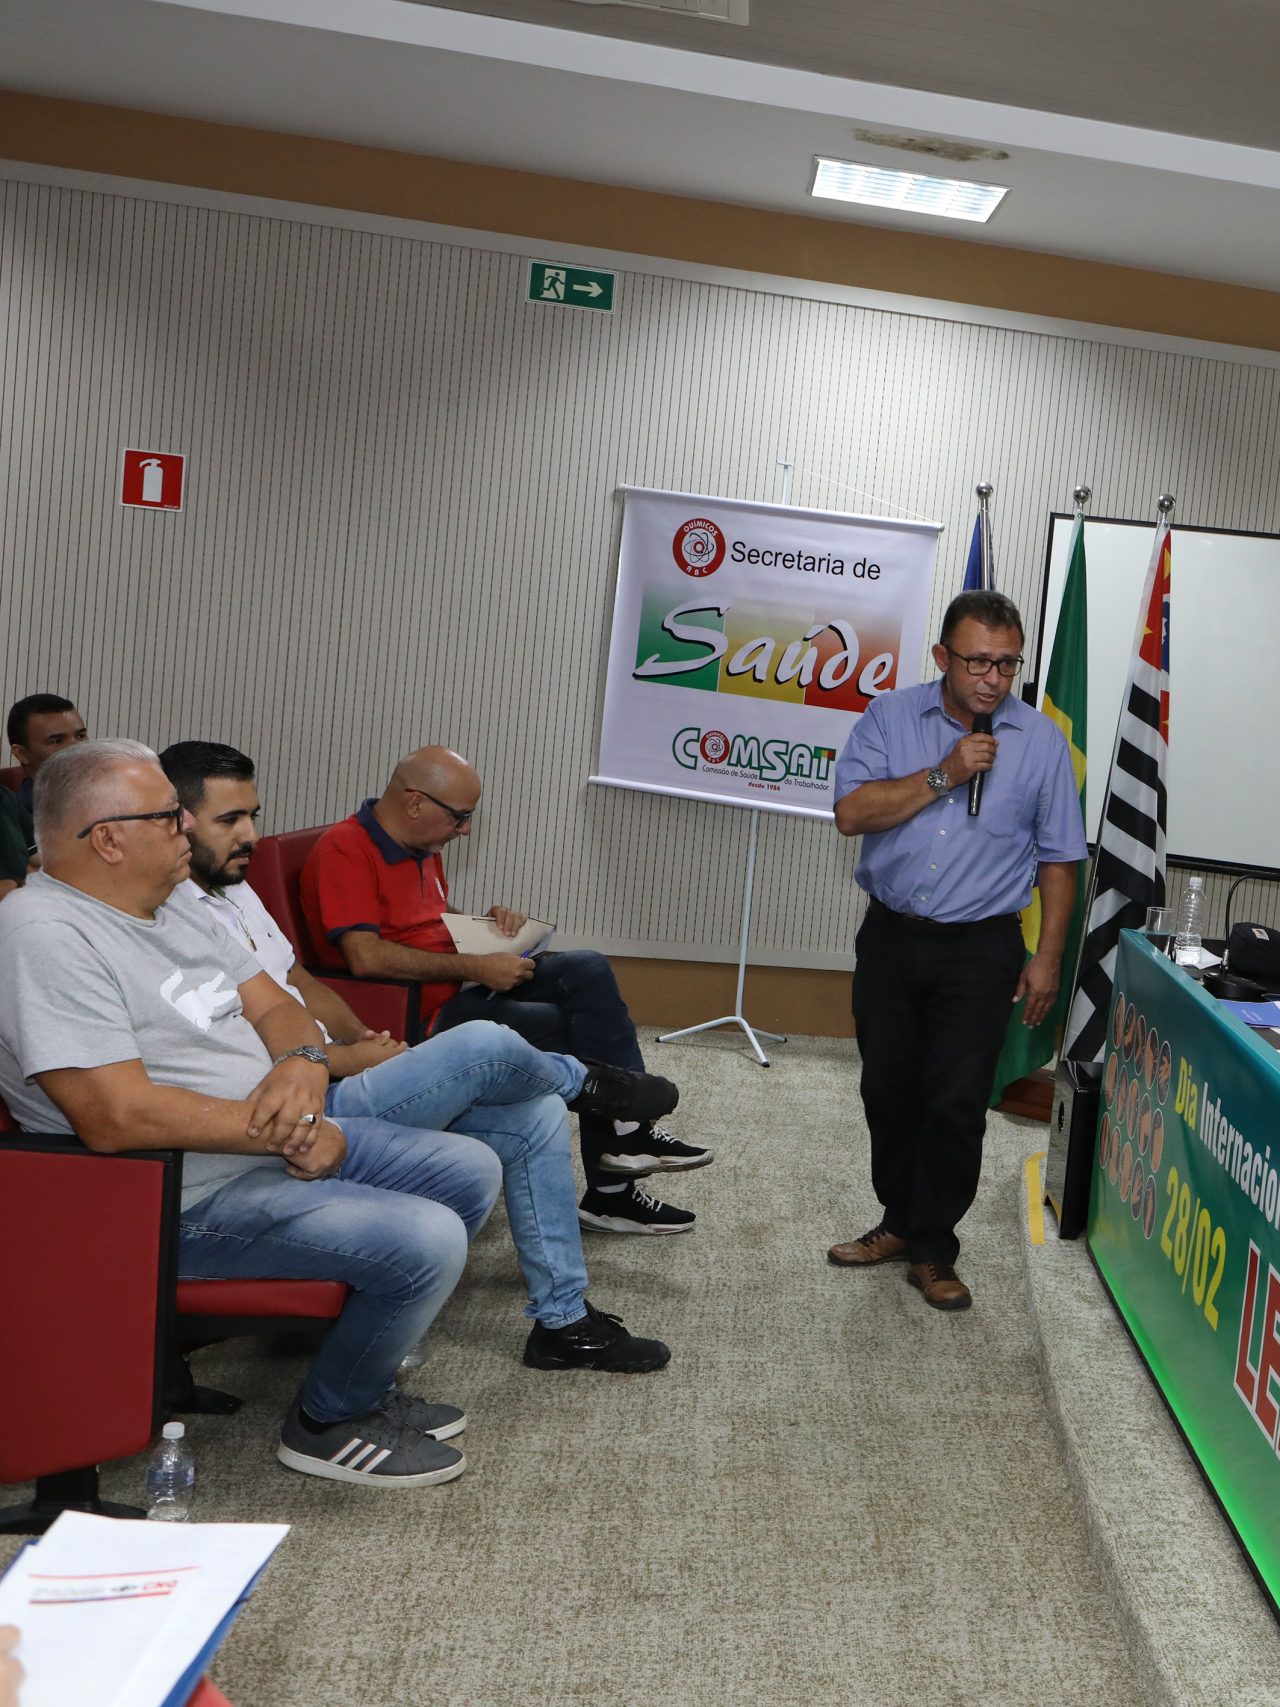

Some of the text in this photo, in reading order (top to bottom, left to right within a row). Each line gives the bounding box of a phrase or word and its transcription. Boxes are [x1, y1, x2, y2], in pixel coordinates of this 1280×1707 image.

[683, 521, 718, 537] QUÍMICOS
[731, 541, 881, 580] Secretaria de
[631, 597, 893, 698] Saúde
[702, 765, 730, 776] Comissão
[739, 770, 759, 780] Saúde
[784, 777, 793, 785] do
[794, 779, 830, 790] Trabalhador
[1175, 1056, 1199, 1130] Dia
[1160, 1166, 1227, 1332] 28/02
